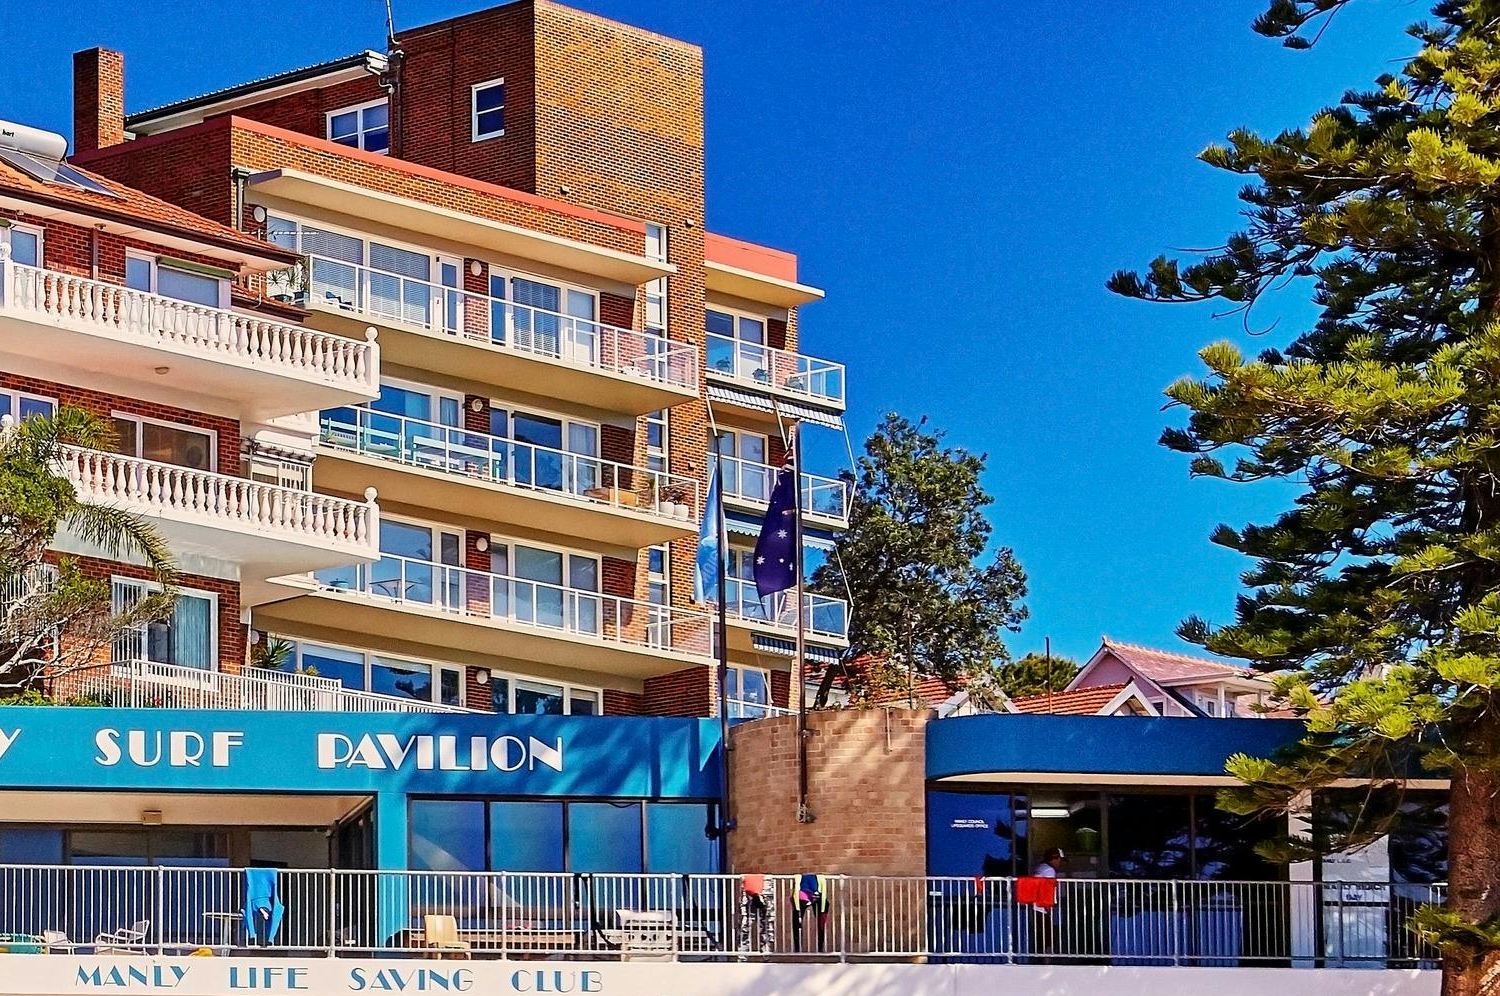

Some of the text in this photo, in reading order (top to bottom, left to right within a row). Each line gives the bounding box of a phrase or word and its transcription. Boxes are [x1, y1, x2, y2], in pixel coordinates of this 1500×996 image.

[94, 728, 244, 767] SURF
[317, 733, 563, 772] PAVILION
[75, 965, 603, 993] MANLY LIFE SAVING CLUB
